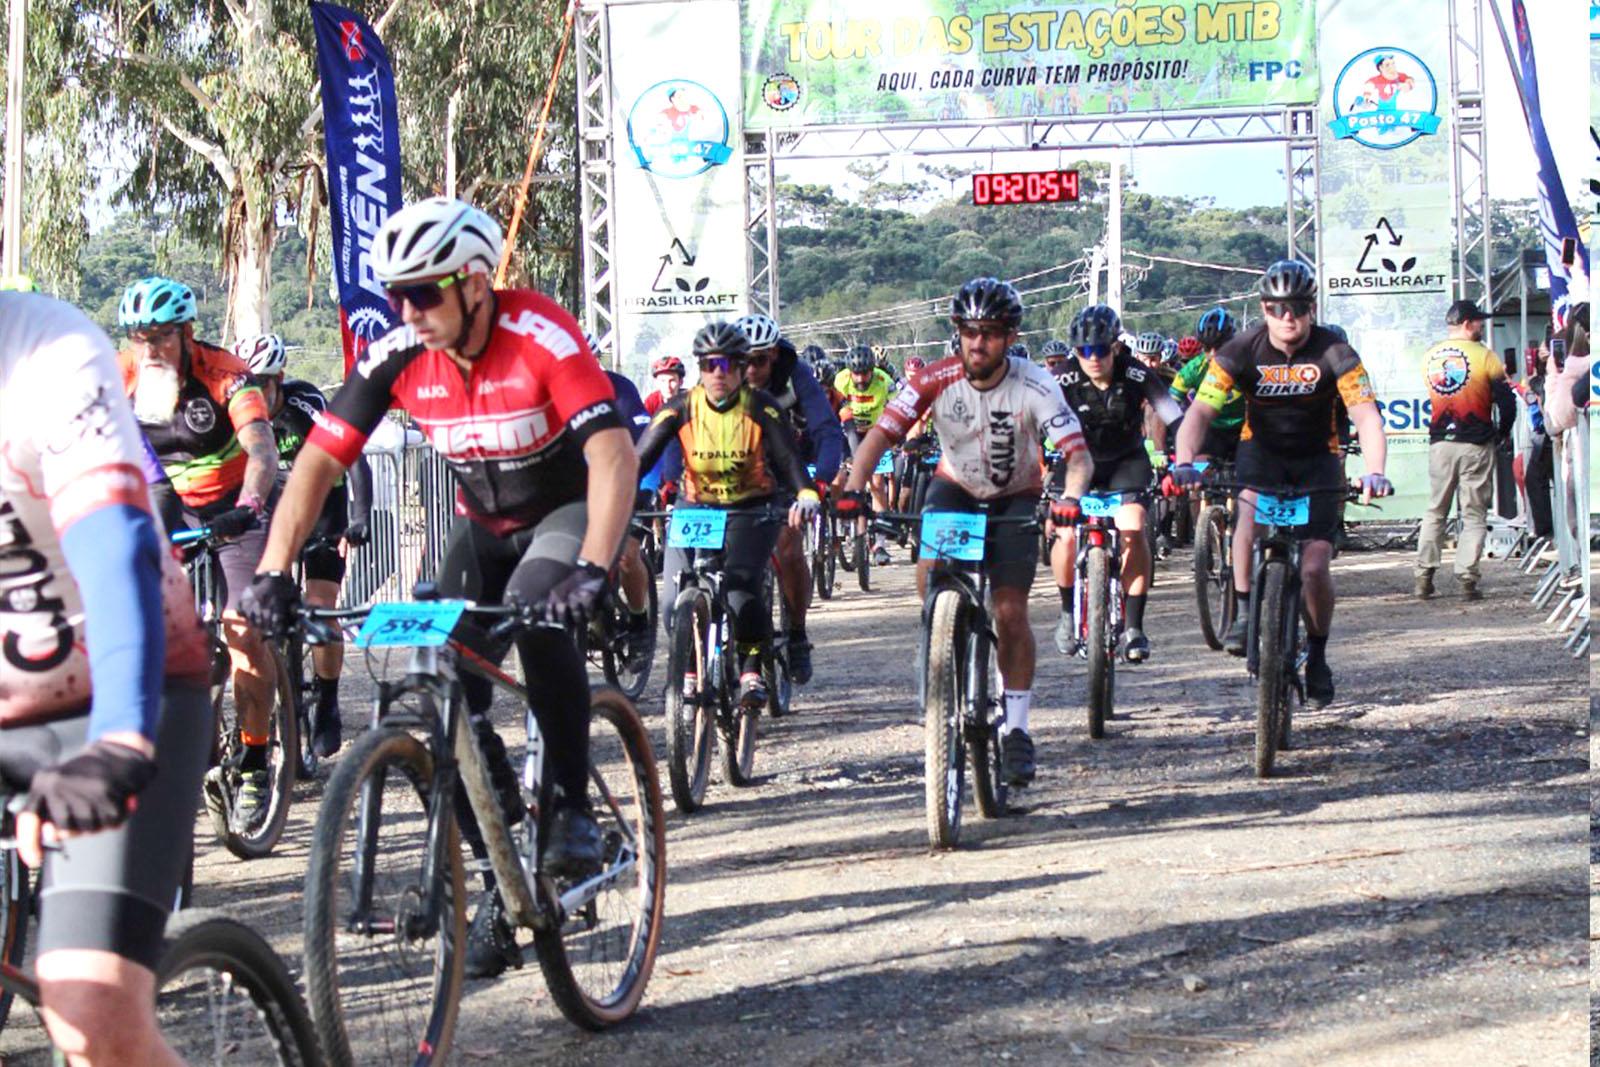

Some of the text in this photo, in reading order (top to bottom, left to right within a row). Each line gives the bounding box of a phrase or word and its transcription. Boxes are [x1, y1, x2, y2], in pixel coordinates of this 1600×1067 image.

[780, 0, 1281, 62] TOUR DAS ESTAÇÕES MTB
[877, 57, 1189, 92] AQUI, CADA CURVA TEM PROPÓSITO!
[1249, 60, 1302, 82] FPC
[1348, 111, 1421, 129] Posto 47
[975, 173, 1077, 203] 09:20:54
[1329, 275, 1446, 289] BRASILKRAFT
[1256, 383, 1316, 397] BIKES
[681, 522, 712, 536] 673
